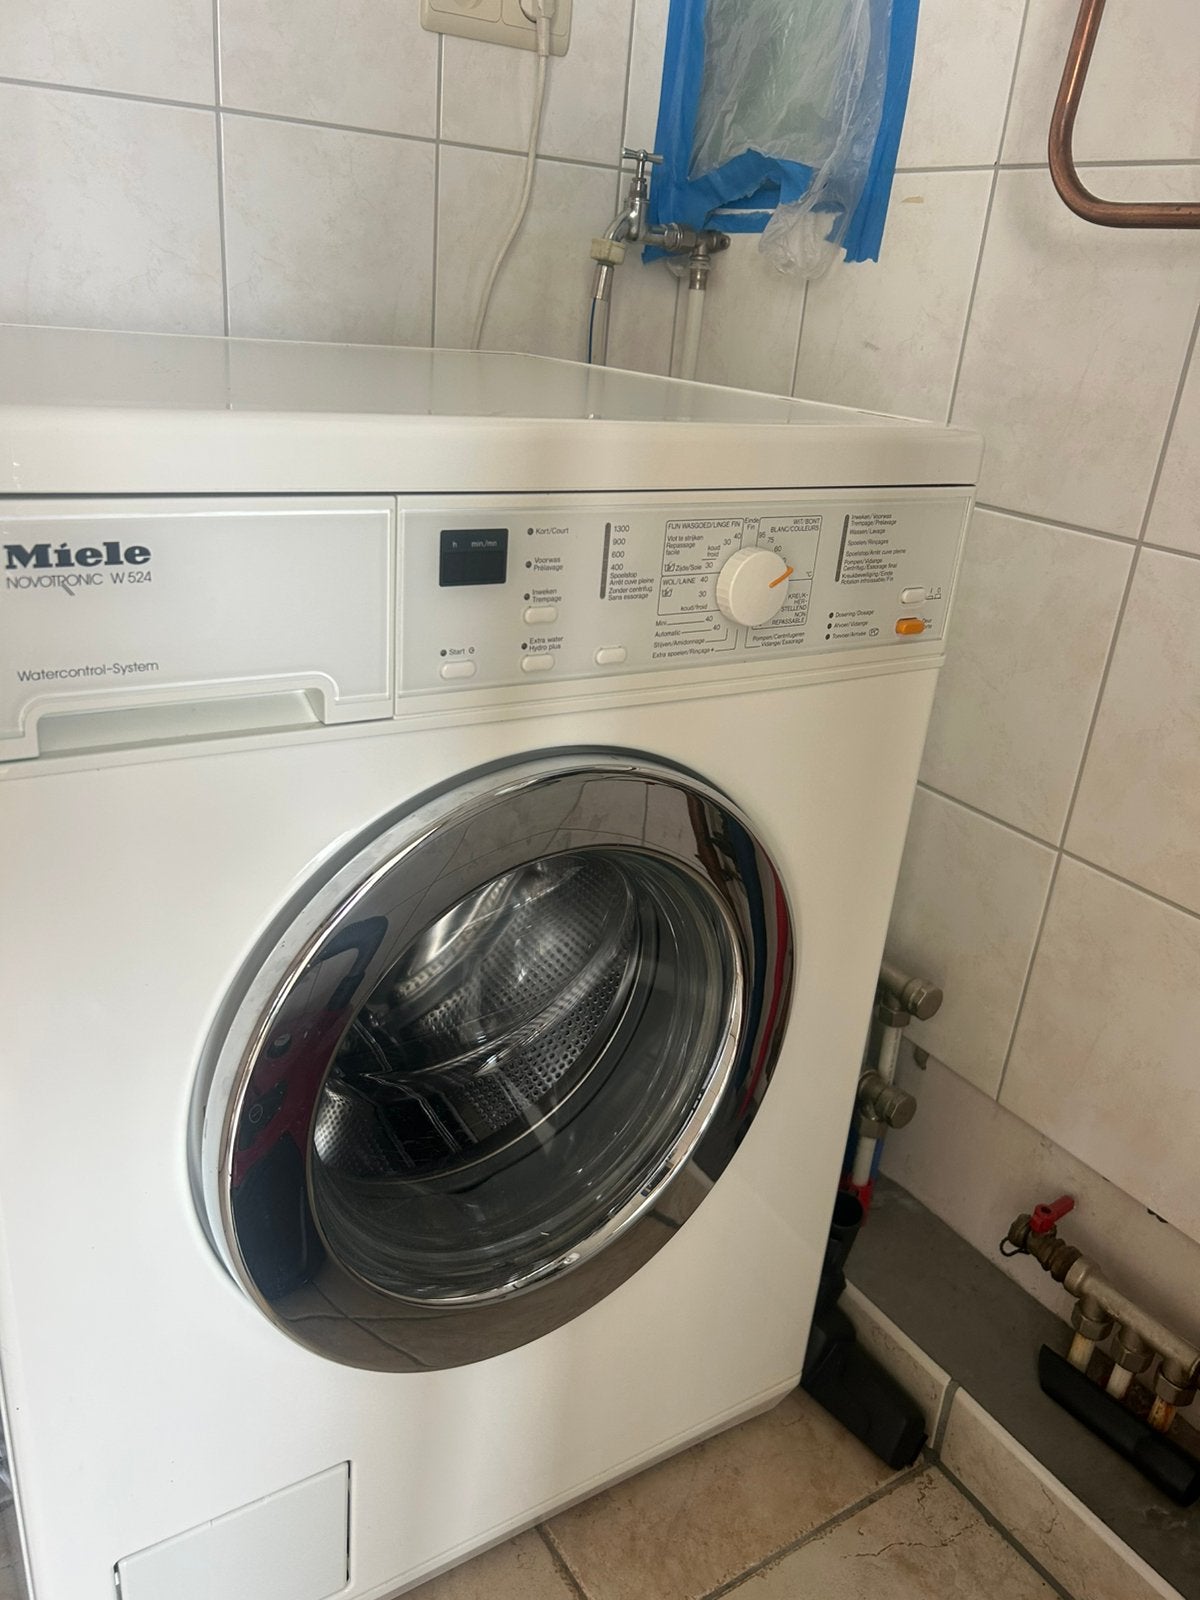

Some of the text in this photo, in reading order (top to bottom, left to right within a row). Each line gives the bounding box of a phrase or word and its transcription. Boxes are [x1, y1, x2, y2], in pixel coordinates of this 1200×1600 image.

[770, 525, 819, 533] BLANC/COULEURS
[3, 542, 151, 569] Miele
[7, 571, 151, 596] NOVOTRONIC W 524
[663, 578, 695, 586] WOL/LAINE
[17, 662, 159, 681] Watercontrol-System
